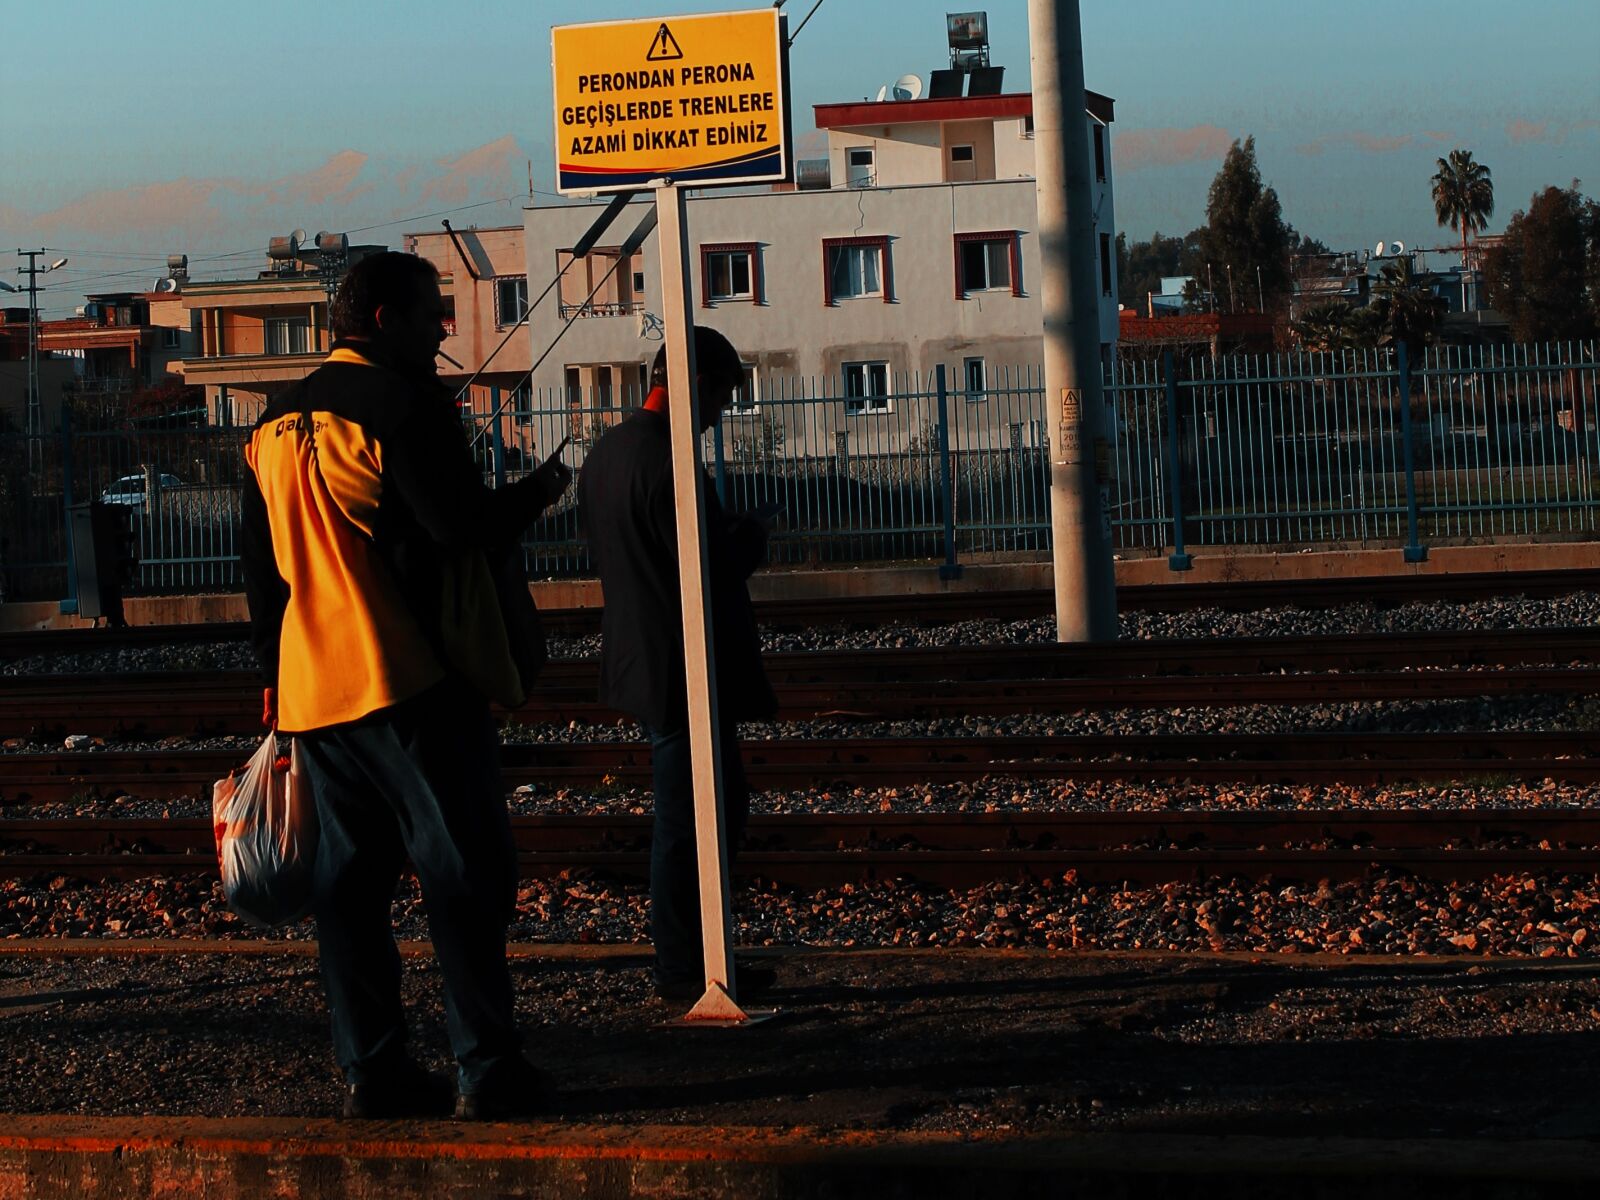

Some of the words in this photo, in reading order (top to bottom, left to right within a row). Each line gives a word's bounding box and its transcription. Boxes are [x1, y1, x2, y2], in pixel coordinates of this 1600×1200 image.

[578, 68, 675, 93] PERONDAN
[681, 63, 755, 86] PERONA
[562, 99, 674, 129] GEÇİŞLERDE
[678, 91, 774, 117] TRENLERE
[570, 129, 627, 156] AZAMİ
[632, 127, 700, 151] DİKKAT
[706, 119, 769, 147] EDİNİZ
